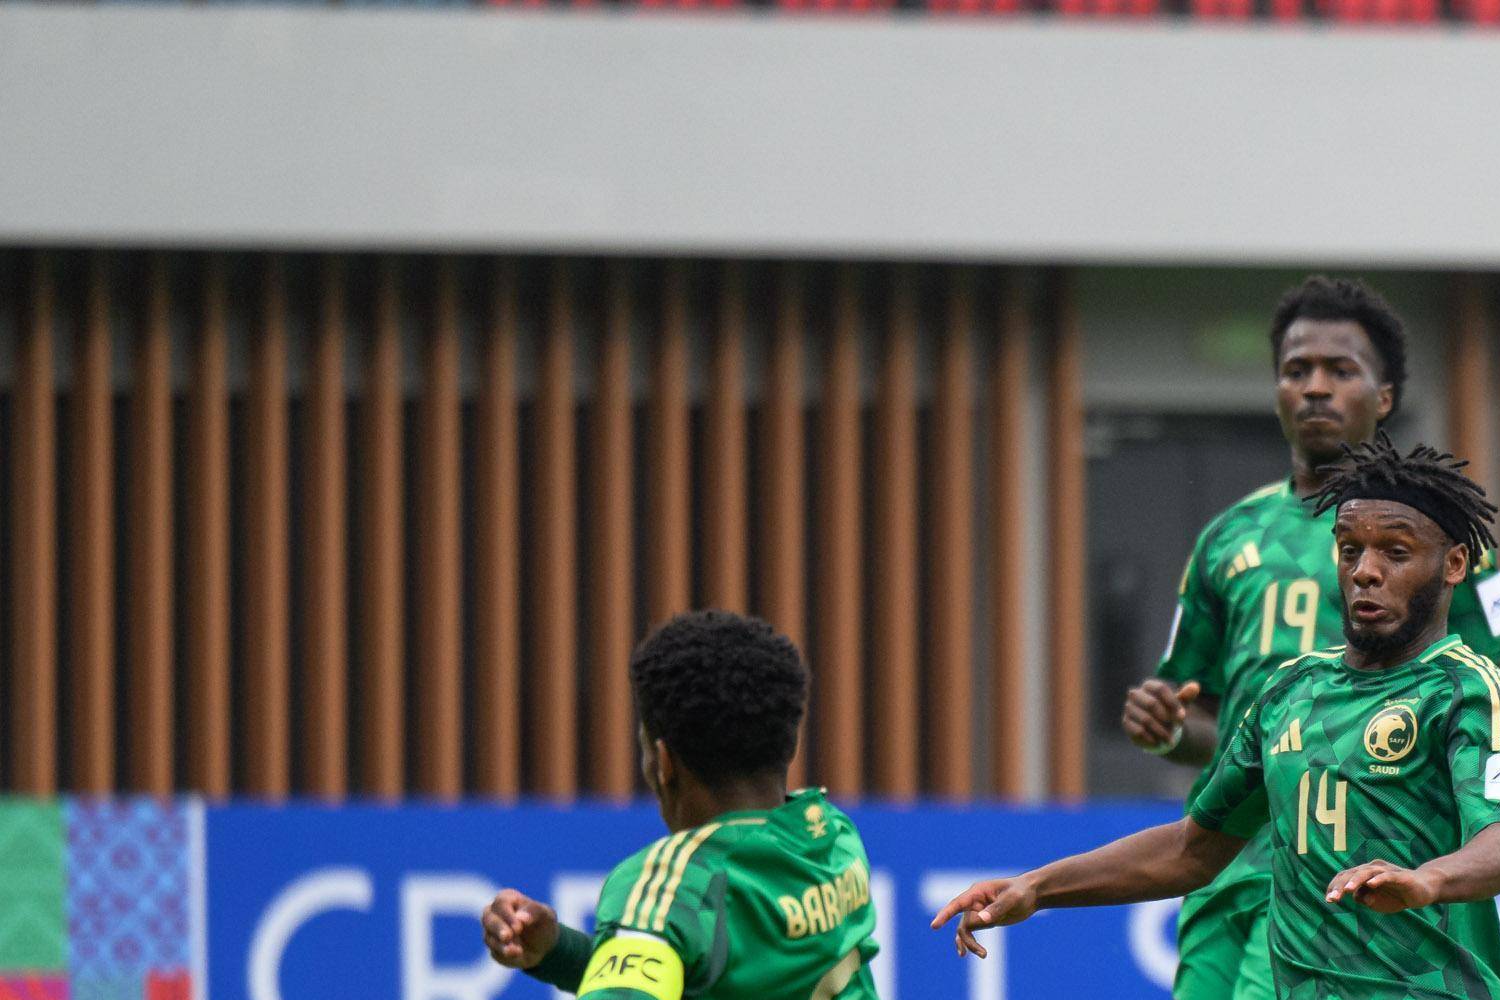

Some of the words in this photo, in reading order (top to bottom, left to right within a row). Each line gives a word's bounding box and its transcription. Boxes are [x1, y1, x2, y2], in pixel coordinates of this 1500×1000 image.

[1259, 579, 1320, 656] 19
[1369, 764, 1400, 775] SAUDI
[1297, 769, 1348, 855] 14
[589, 954, 662, 983] AFC
